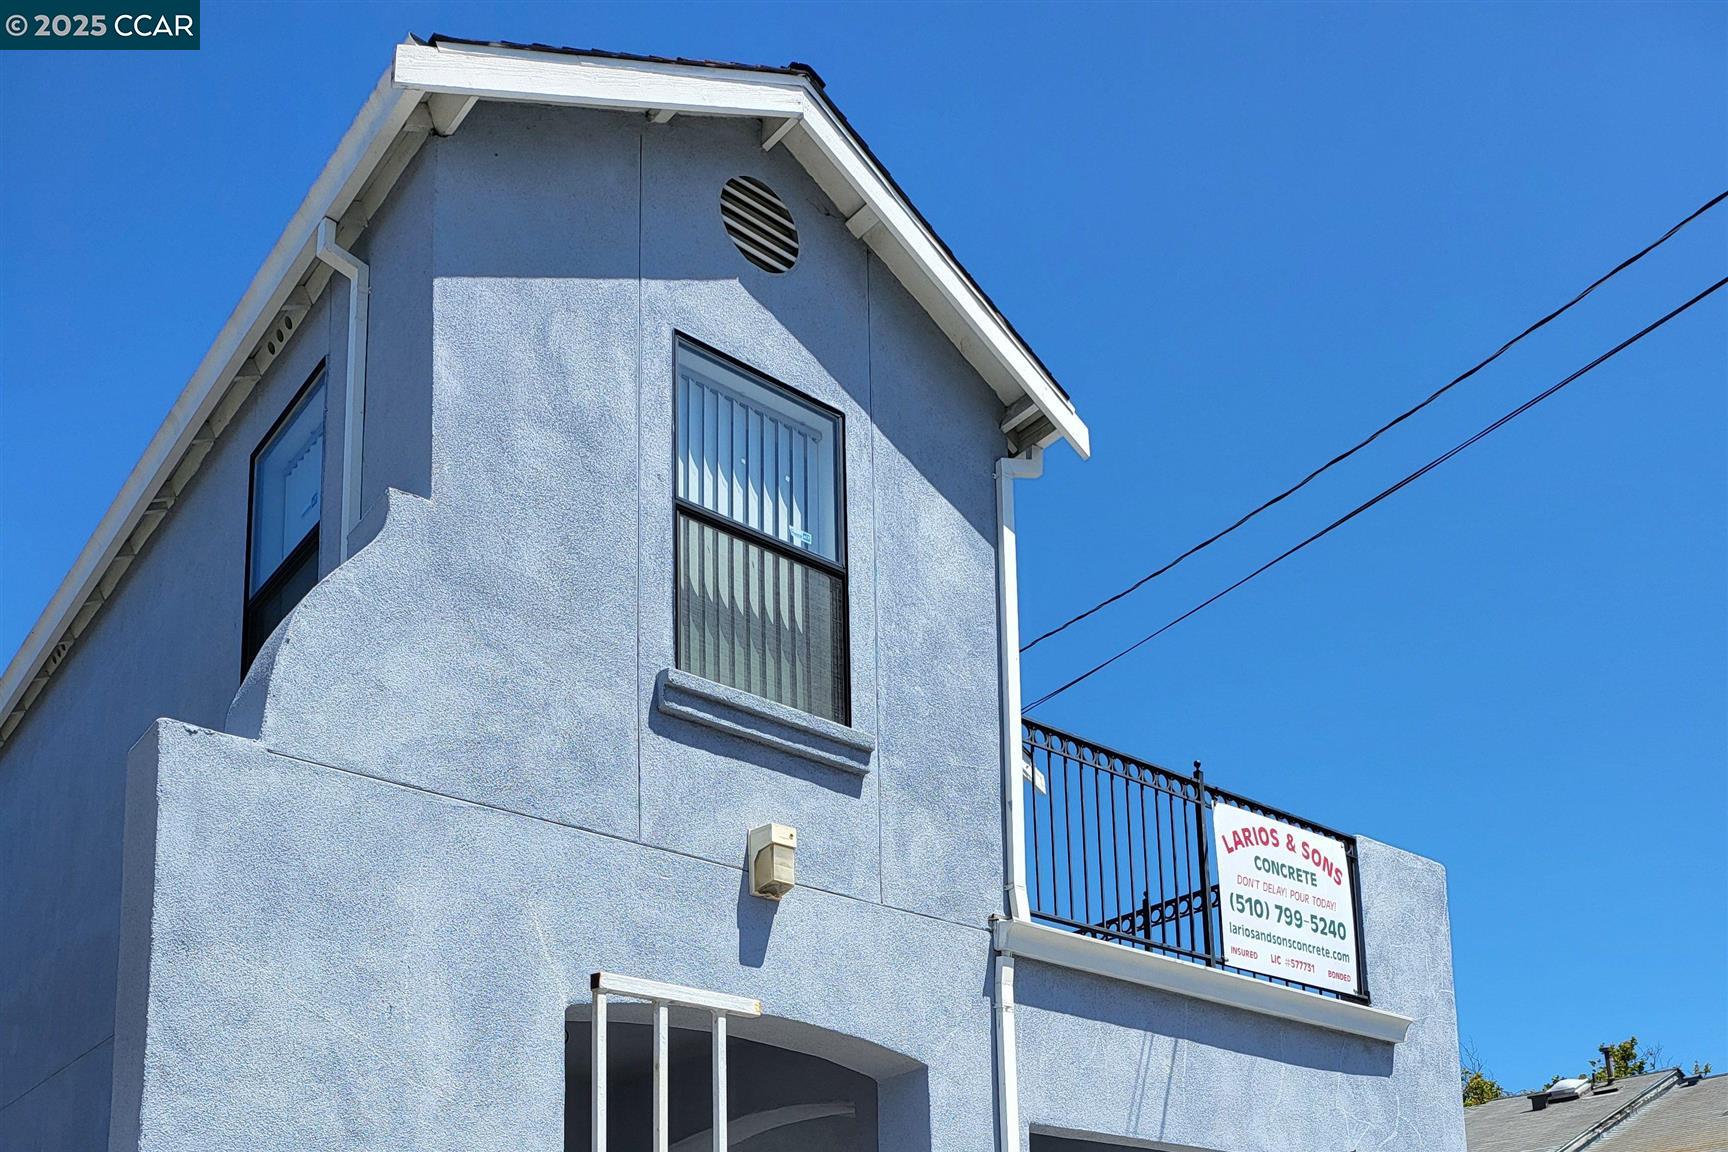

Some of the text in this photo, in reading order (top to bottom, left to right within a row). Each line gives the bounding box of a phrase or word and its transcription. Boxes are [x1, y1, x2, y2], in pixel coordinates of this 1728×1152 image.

[1222, 826, 1343, 886] LARIOS & SONS
[1254, 855, 1318, 887] CONCRETE
[1237, 874, 1337, 911] DON'T DELAY! POUR TODAY!
[1229, 892, 1347, 941] (510) 799-5240
[1229, 921, 1350, 963] lariosandsonsconcrete.com
[1230, 945, 1259, 960] INSURED
[1270, 954, 1281, 965] LIC
[1327, 970, 1352, 982] BONDED
